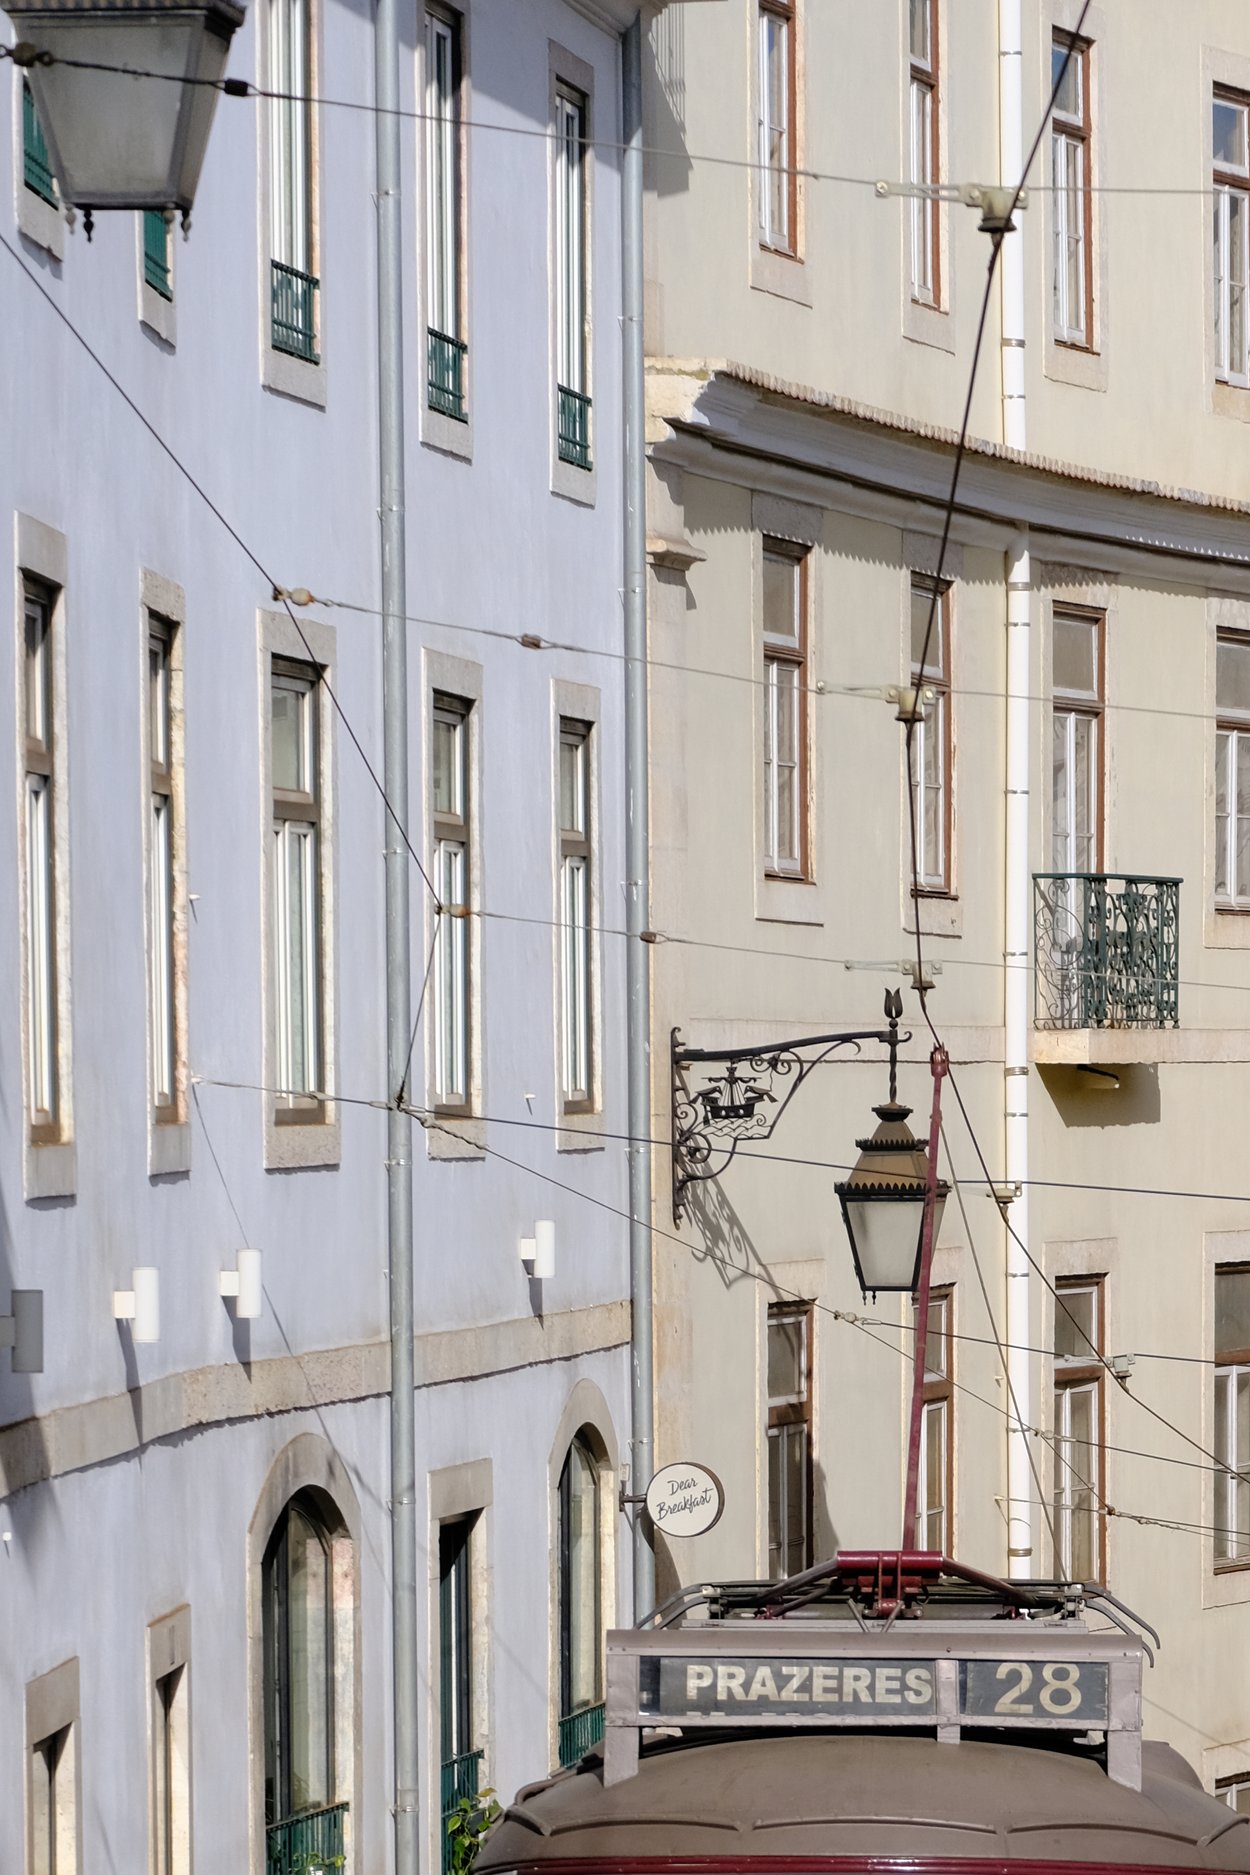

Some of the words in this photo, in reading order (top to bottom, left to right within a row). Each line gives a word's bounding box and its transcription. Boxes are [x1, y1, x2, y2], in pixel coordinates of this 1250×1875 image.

[656, 1487, 714, 1522] Breakfast
[667, 1477, 698, 1496] Dear
[686, 1664, 933, 1704] PRAZERES
[994, 1662, 1082, 1715] 28
